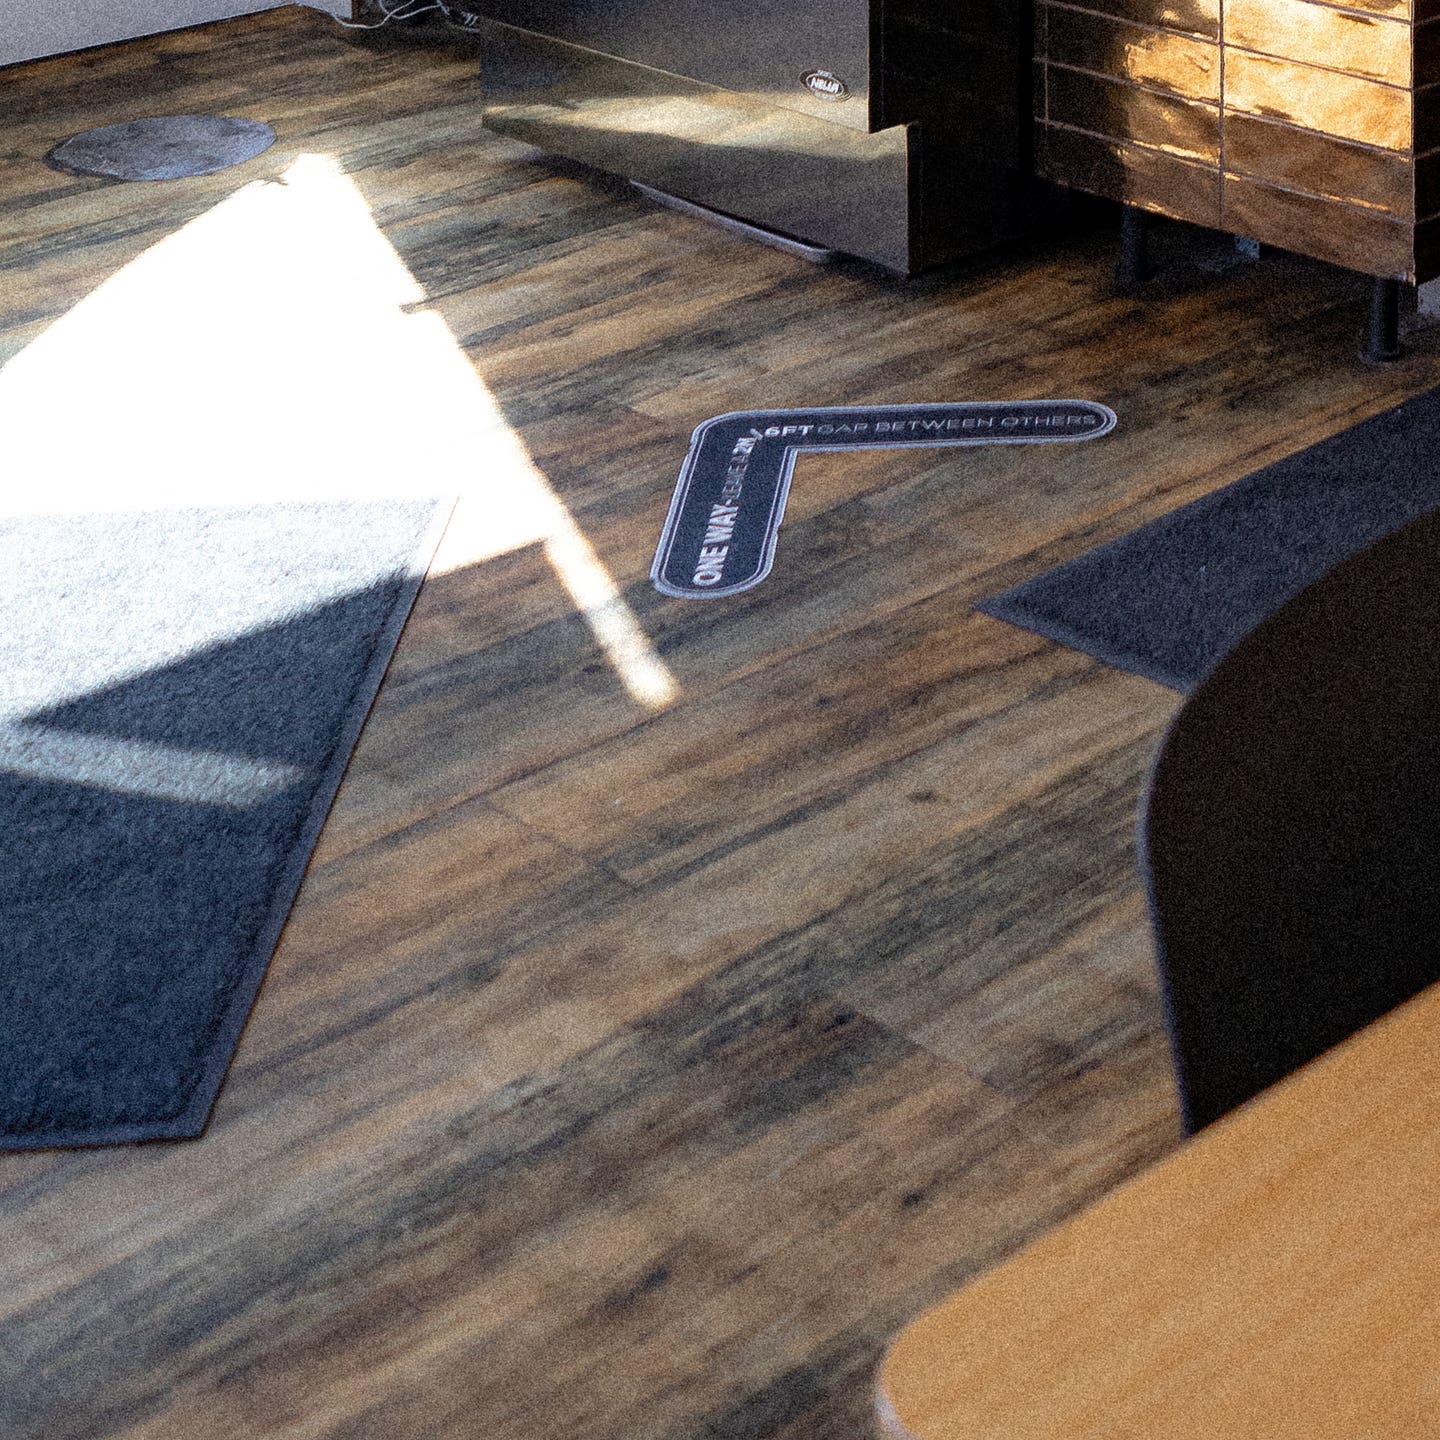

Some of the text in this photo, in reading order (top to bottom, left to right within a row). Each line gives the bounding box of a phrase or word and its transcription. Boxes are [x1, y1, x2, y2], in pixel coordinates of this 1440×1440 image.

[765, 414, 1096, 437] 6FT GAP BETWEEN OTHERS
[693, 545, 729, 587] ONE
